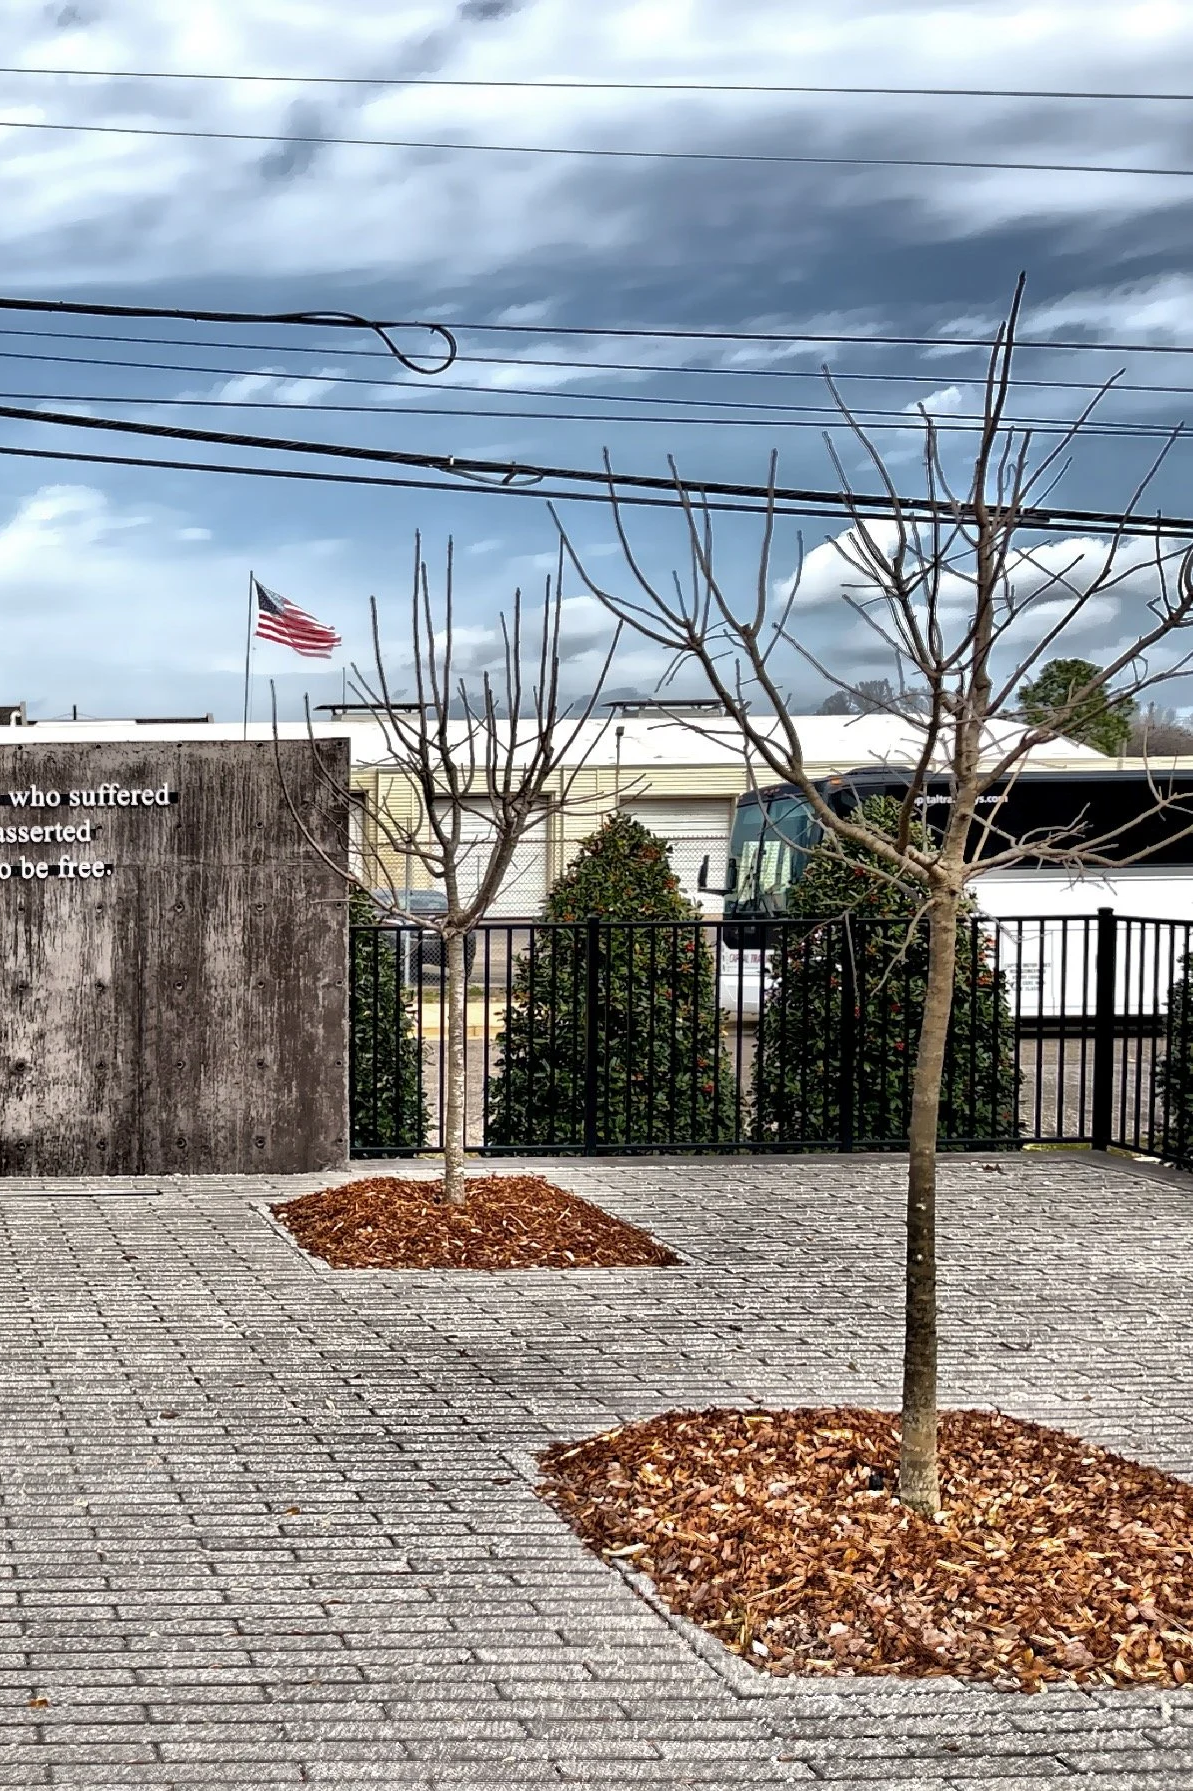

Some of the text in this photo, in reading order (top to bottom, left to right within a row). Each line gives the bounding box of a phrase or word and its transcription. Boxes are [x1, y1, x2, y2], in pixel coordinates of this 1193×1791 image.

[8, 784, 61, 808] who
[69, 782, 171, 807] suffered
[19, 855, 49, 880] be
[57, 854, 112, 879] free.
